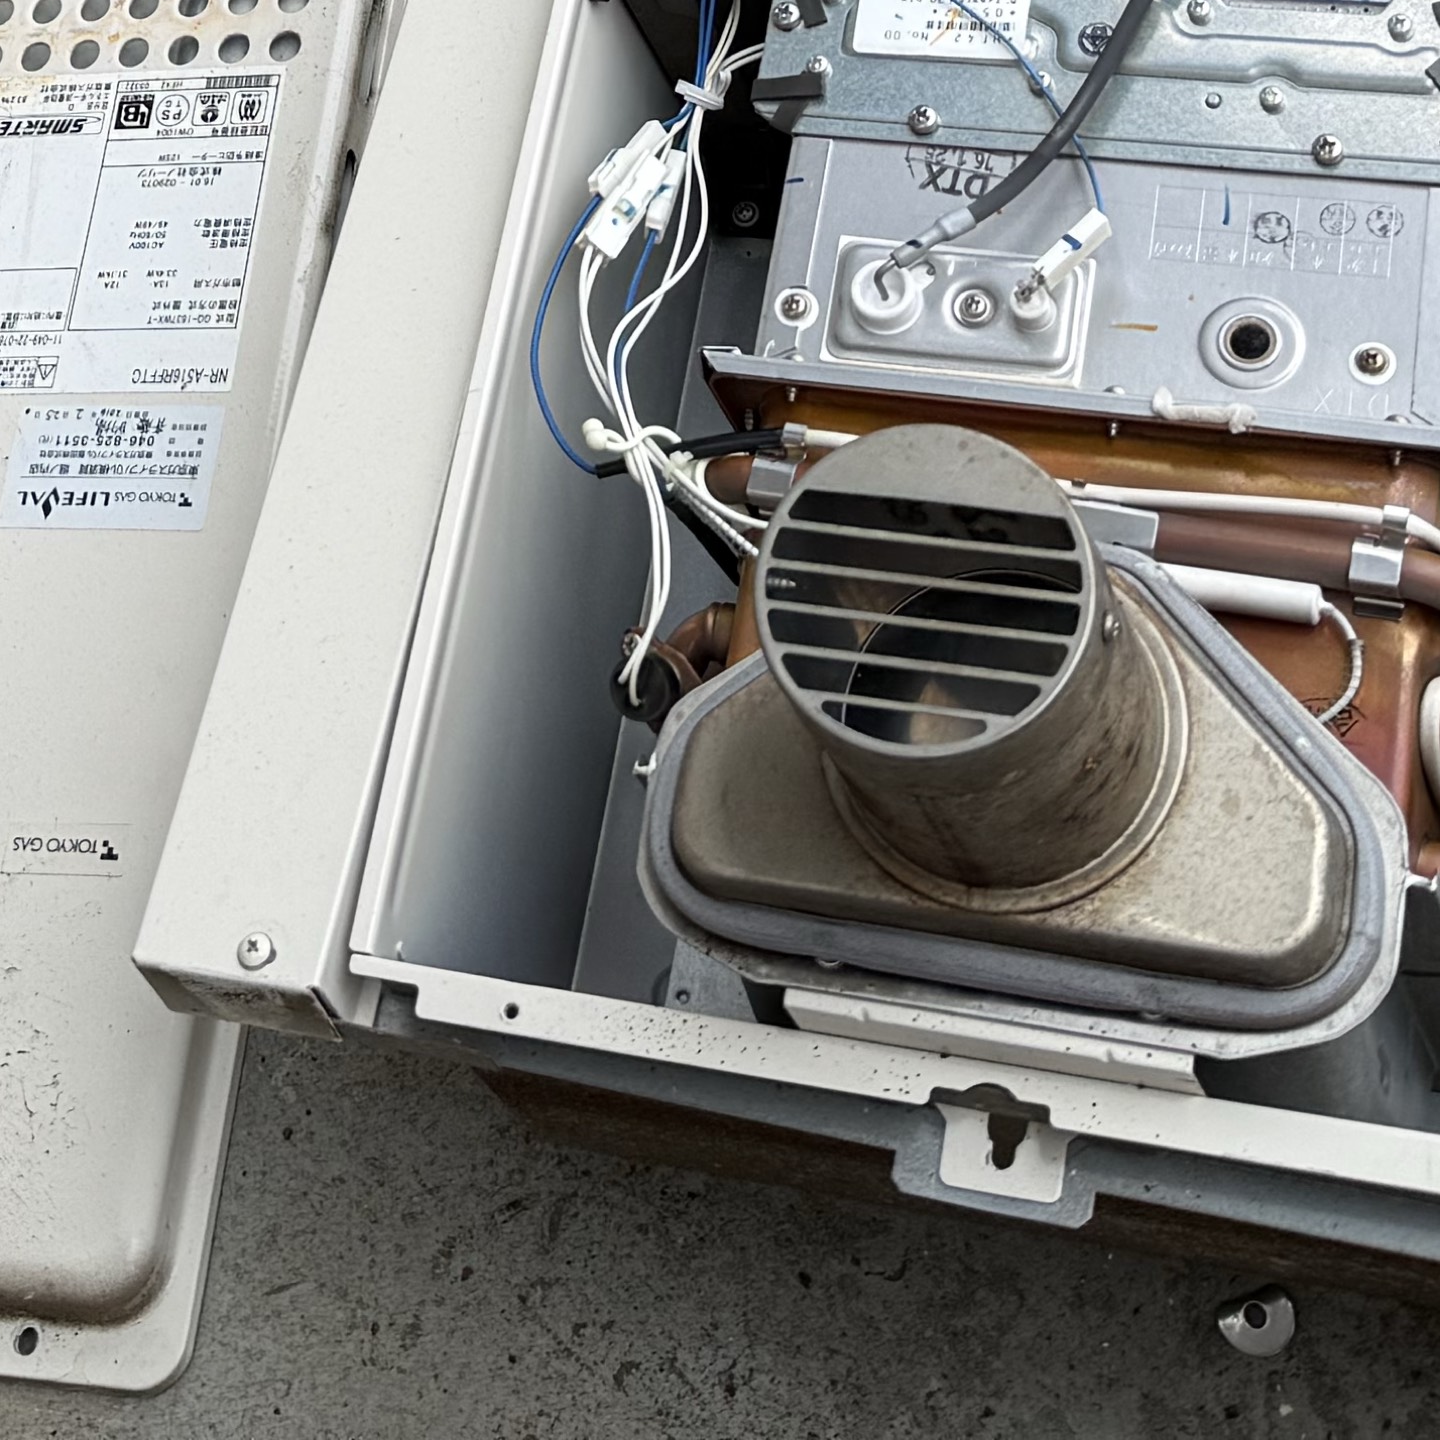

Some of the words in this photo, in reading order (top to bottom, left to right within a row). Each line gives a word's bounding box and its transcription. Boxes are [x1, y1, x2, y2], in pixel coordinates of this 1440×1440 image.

[918, 161, 990, 199] DTX
[102, 280, 120, 288] 12A
[129, 366, 229, 383] NR-A516RFFTC
[54, 434, 155, 446] 046-825-3511
[112, 490, 137, 502] GAS
[137, 490, 177, 503] TOKYO
[11, 837, 43, 851] GAS
[45, 838, 99, 853] TOKYO
